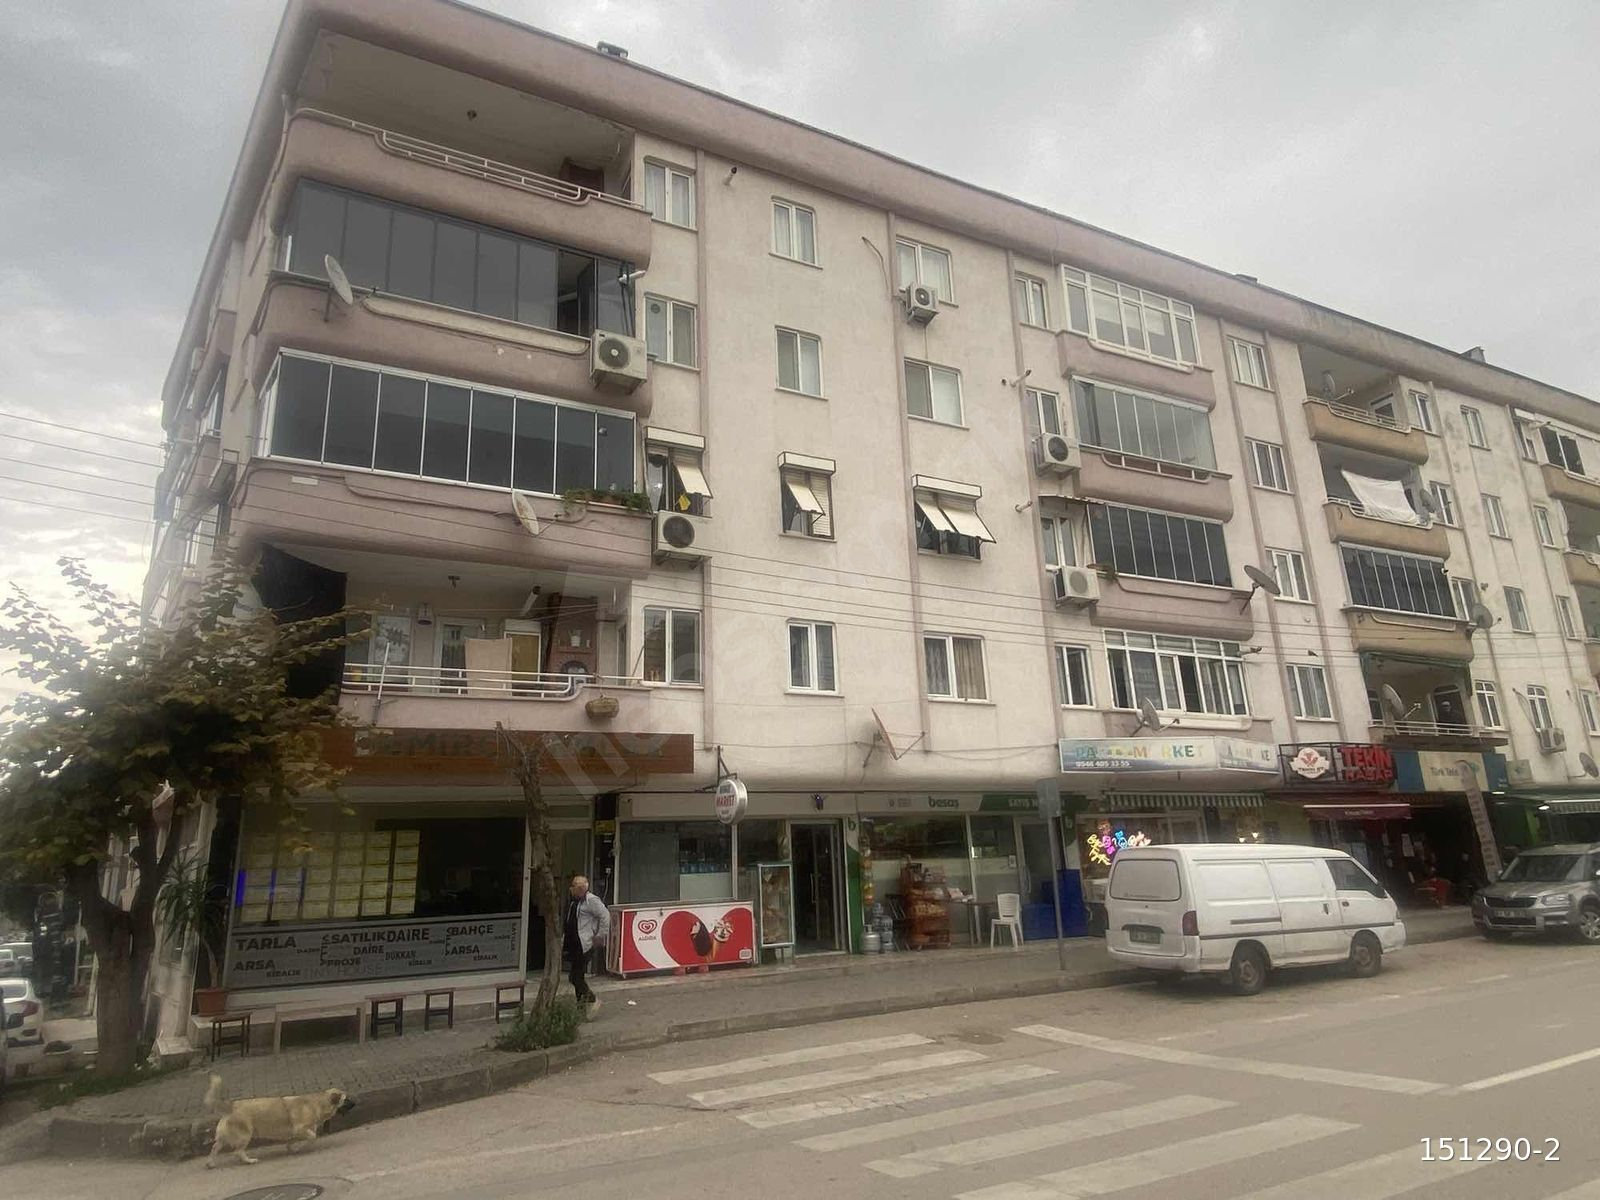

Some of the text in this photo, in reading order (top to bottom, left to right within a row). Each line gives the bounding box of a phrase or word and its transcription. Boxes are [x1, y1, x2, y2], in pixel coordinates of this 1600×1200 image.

[235, 936, 297, 951] TARLA
[331, 931, 386, 944] SATILIK
[451, 944, 480, 955] ARSA
[232, 959, 276, 972] ARSA
